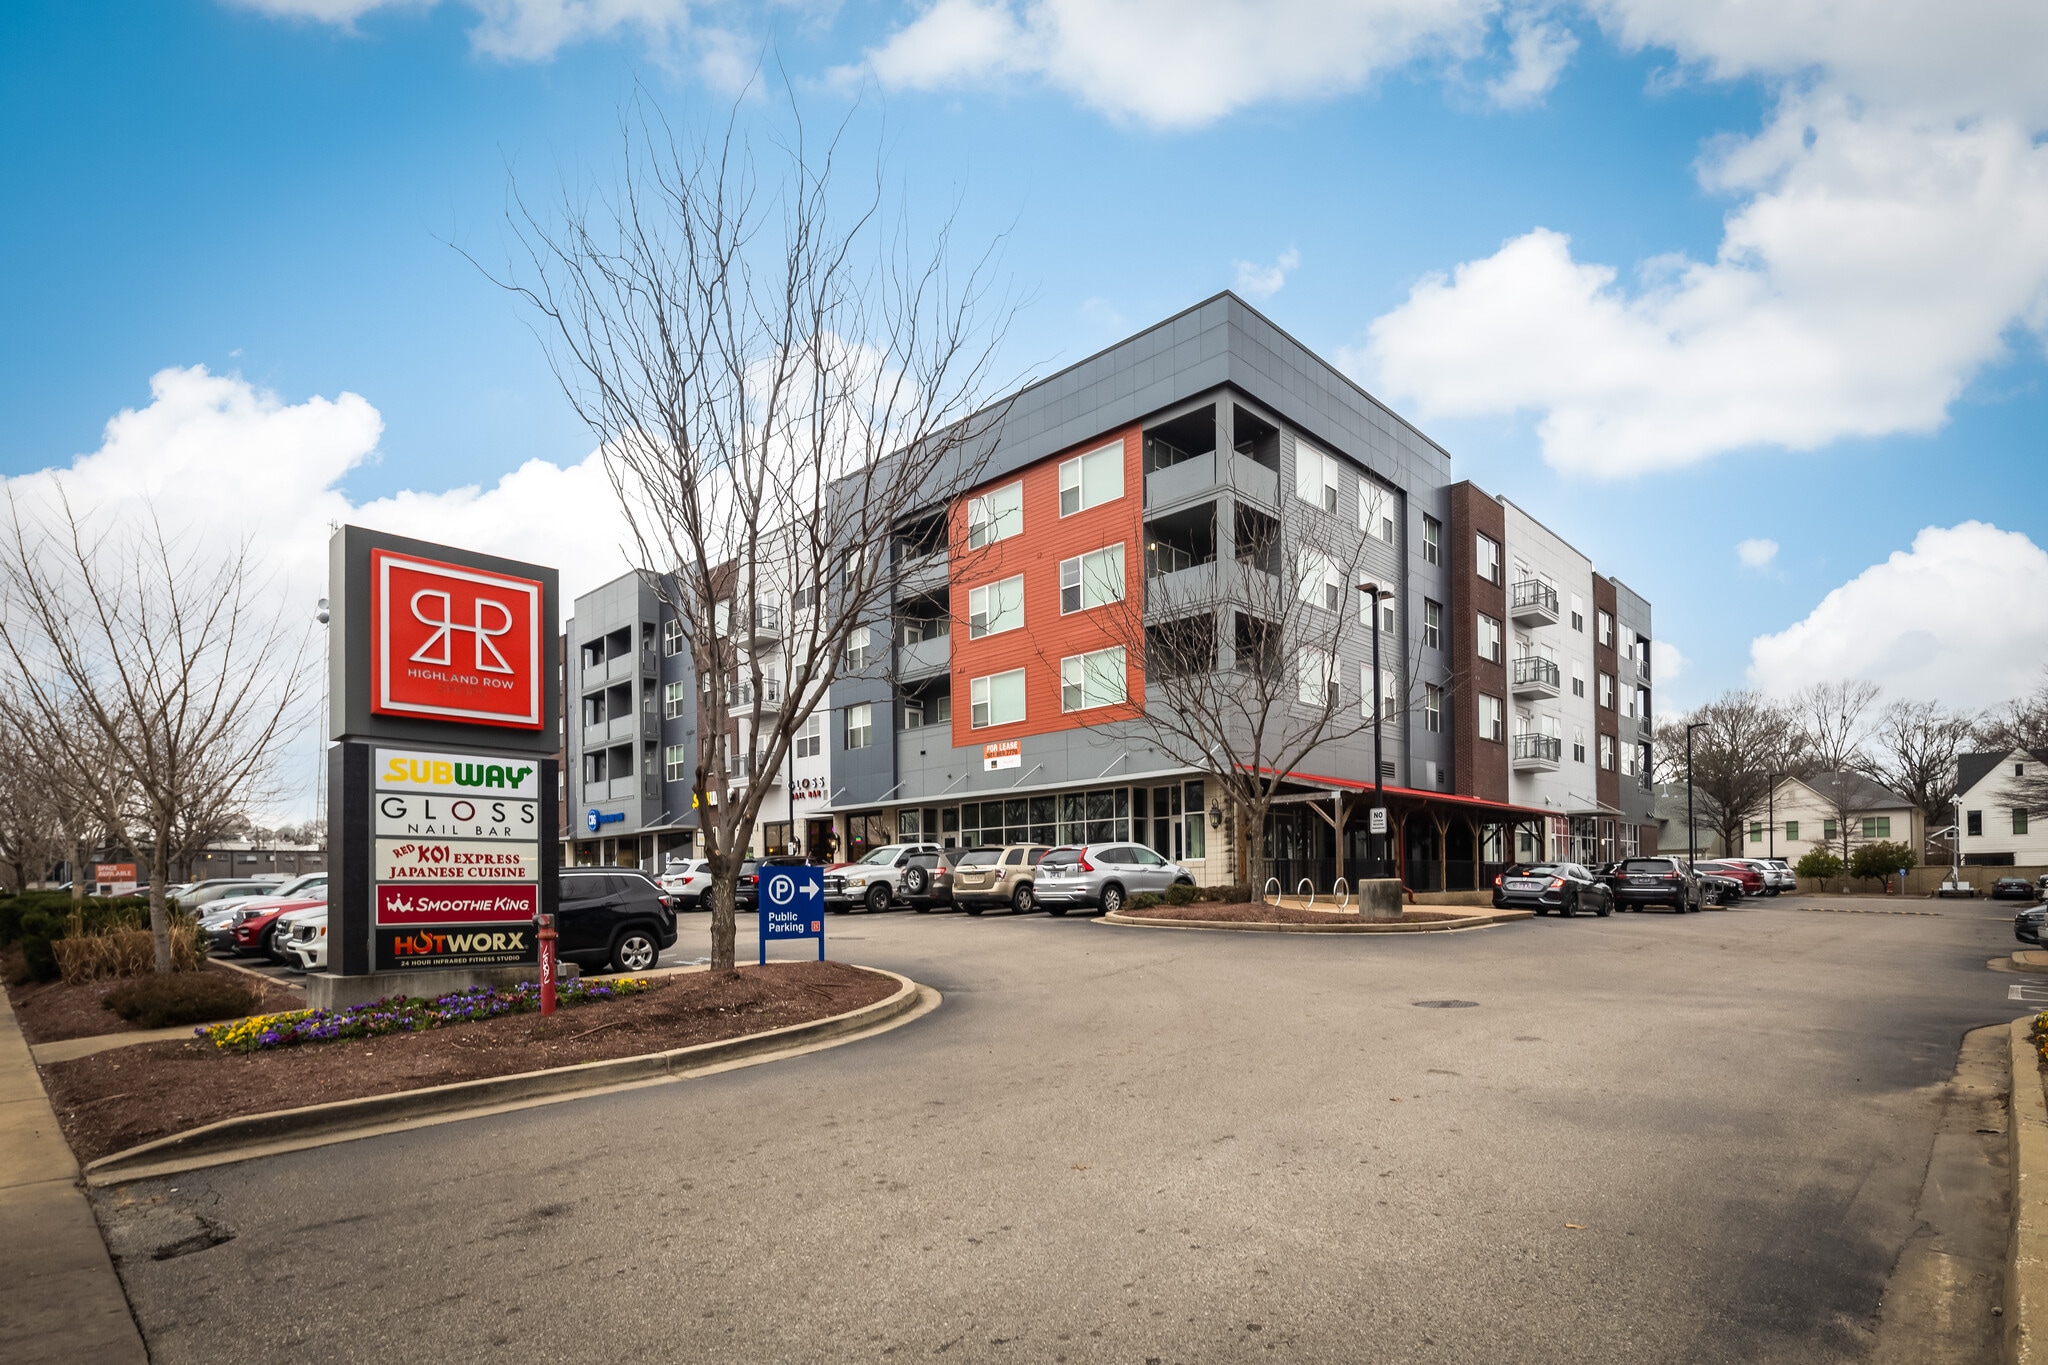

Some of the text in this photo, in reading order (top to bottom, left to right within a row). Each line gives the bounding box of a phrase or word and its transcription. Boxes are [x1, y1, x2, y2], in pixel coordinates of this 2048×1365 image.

[407, 668, 479, 685] HIGHLAND
[483, 677, 514, 690] ROW
[986, 741, 1018, 753] FOR LEASE
[382, 757, 534, 790] SUBWAY
[380, 796, 535, 825] GLOSS
[1373, 811, 1383, 819] NO
[407, 823, 512, 837] NAIL BAR
[392, 843, 520, 865] RED KOI EXPRESS
[388, 866, 526, 879] JAPANESE CUISINE
[416, 897, 493, 912] SMOOTHIE
[768, 911, 798, 922] Public
[768, 922, 804, 934] Parking
[394, 929, 525, 955] HOTWORX
